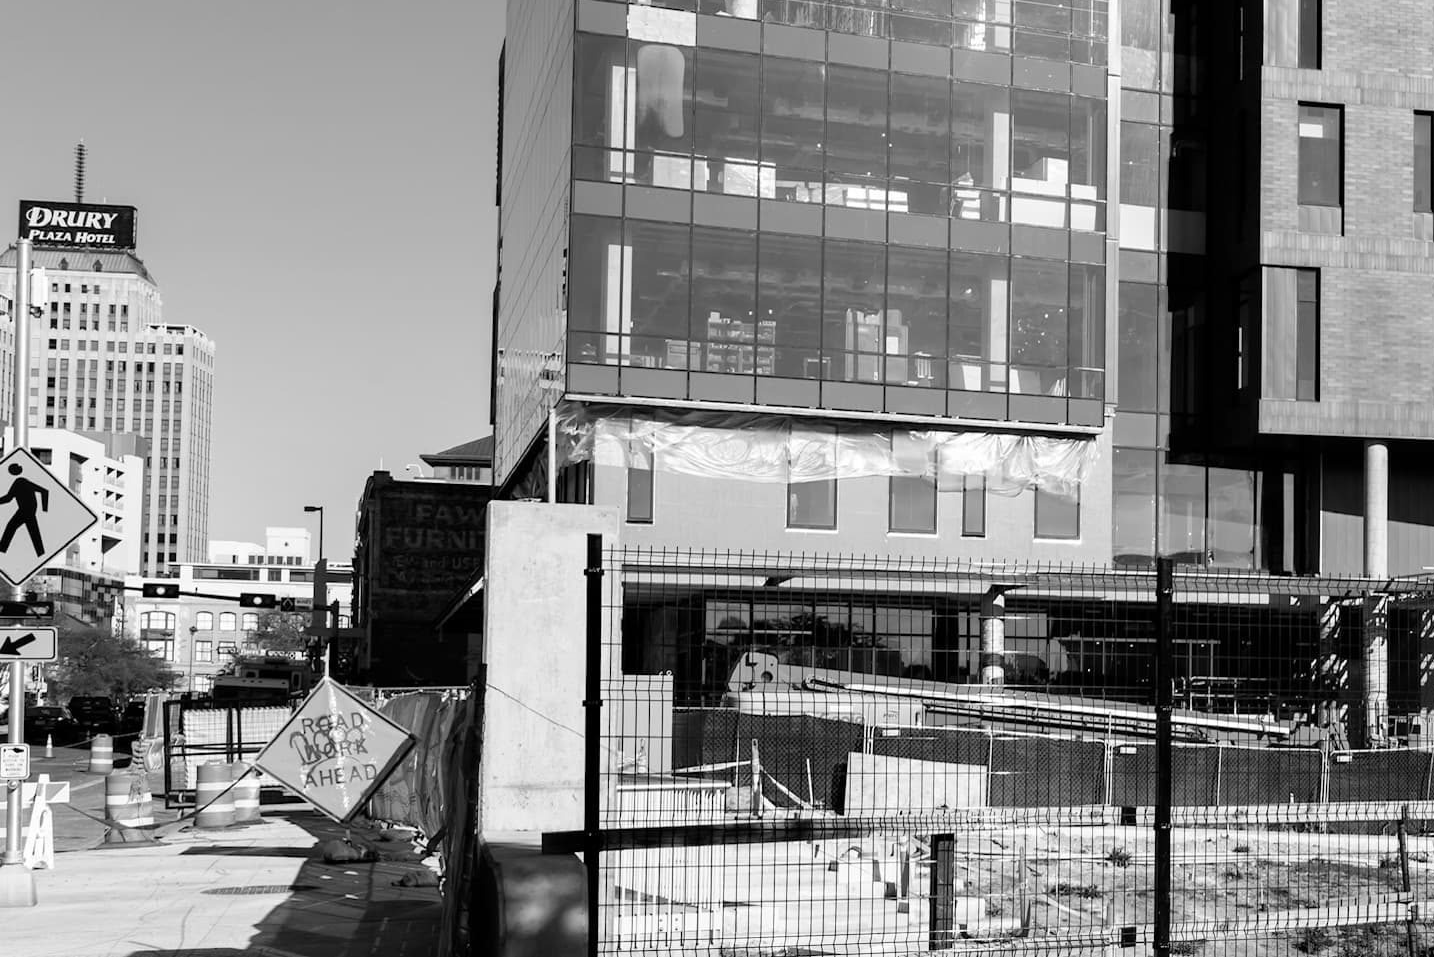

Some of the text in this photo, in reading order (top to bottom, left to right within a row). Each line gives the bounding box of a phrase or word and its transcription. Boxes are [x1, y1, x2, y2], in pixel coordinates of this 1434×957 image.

[26, 206, 118, 230] DRURY
[29, 229, 116, 244] PLAZA HOTEL
[302, 712, 364, 734] ROAD
[304, 763, 377, 789] AHEAD
